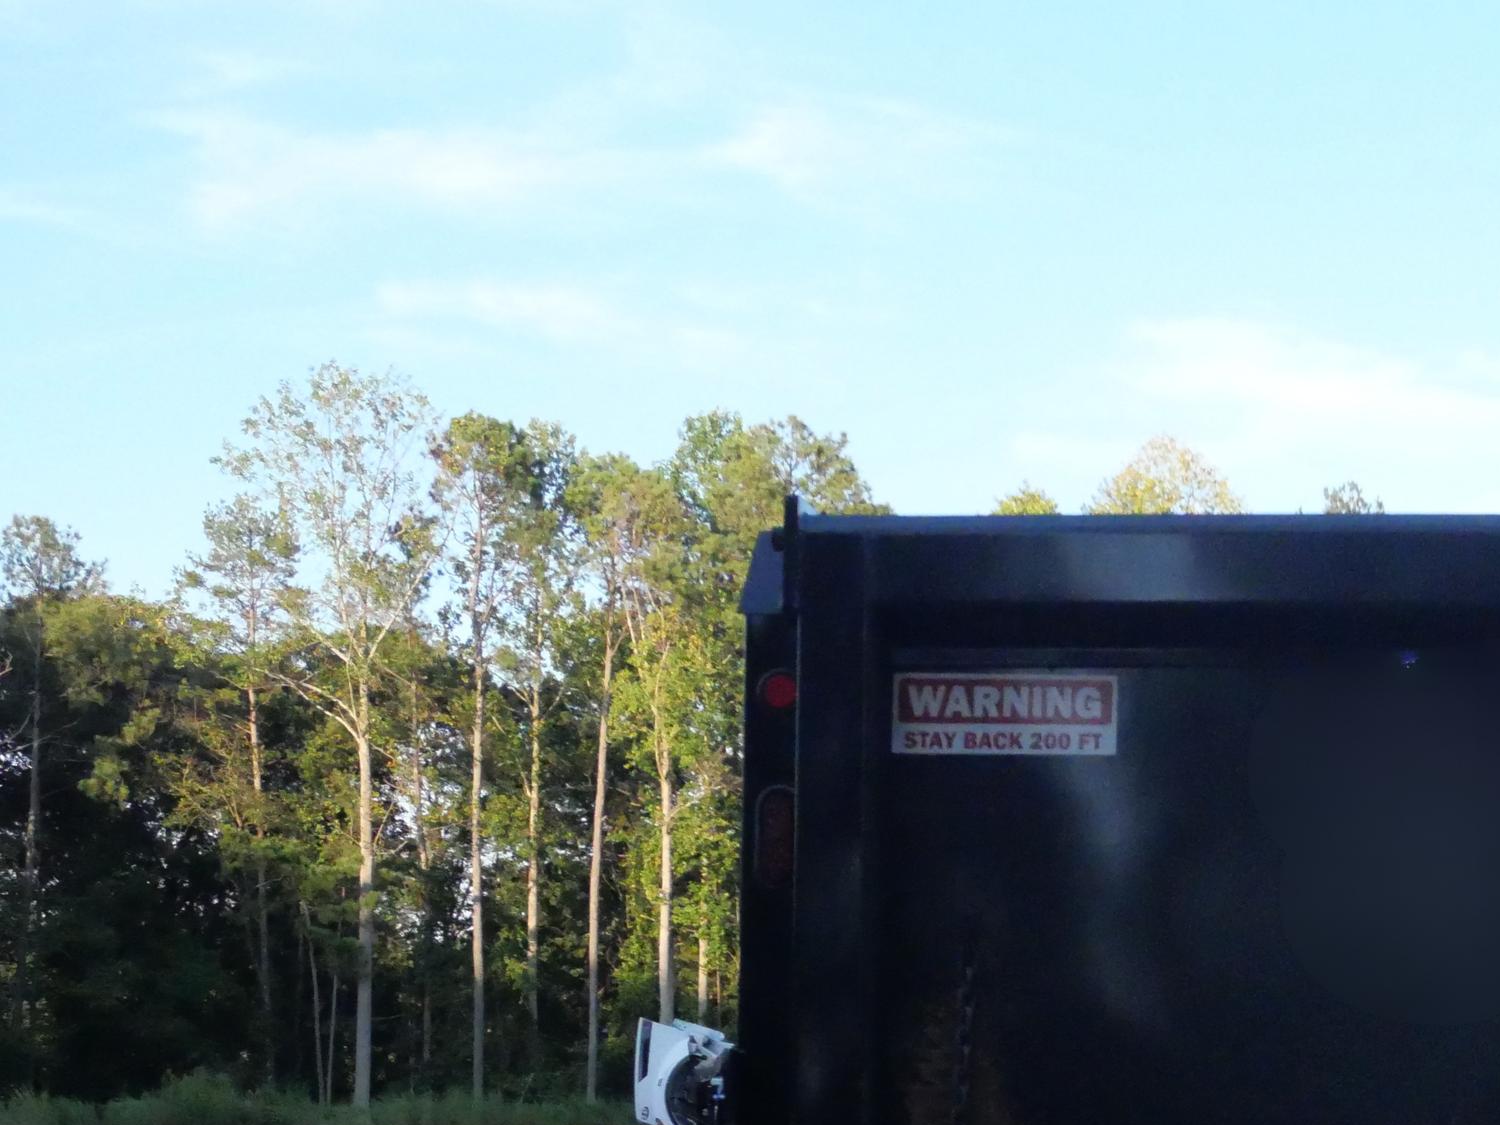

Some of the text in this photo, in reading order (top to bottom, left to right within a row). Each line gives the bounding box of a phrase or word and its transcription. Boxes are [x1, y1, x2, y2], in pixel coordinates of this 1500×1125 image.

[907, 685, 1101, 718] WARNING
[903, 731, 1103, 750] STAY BACK 200 FT
